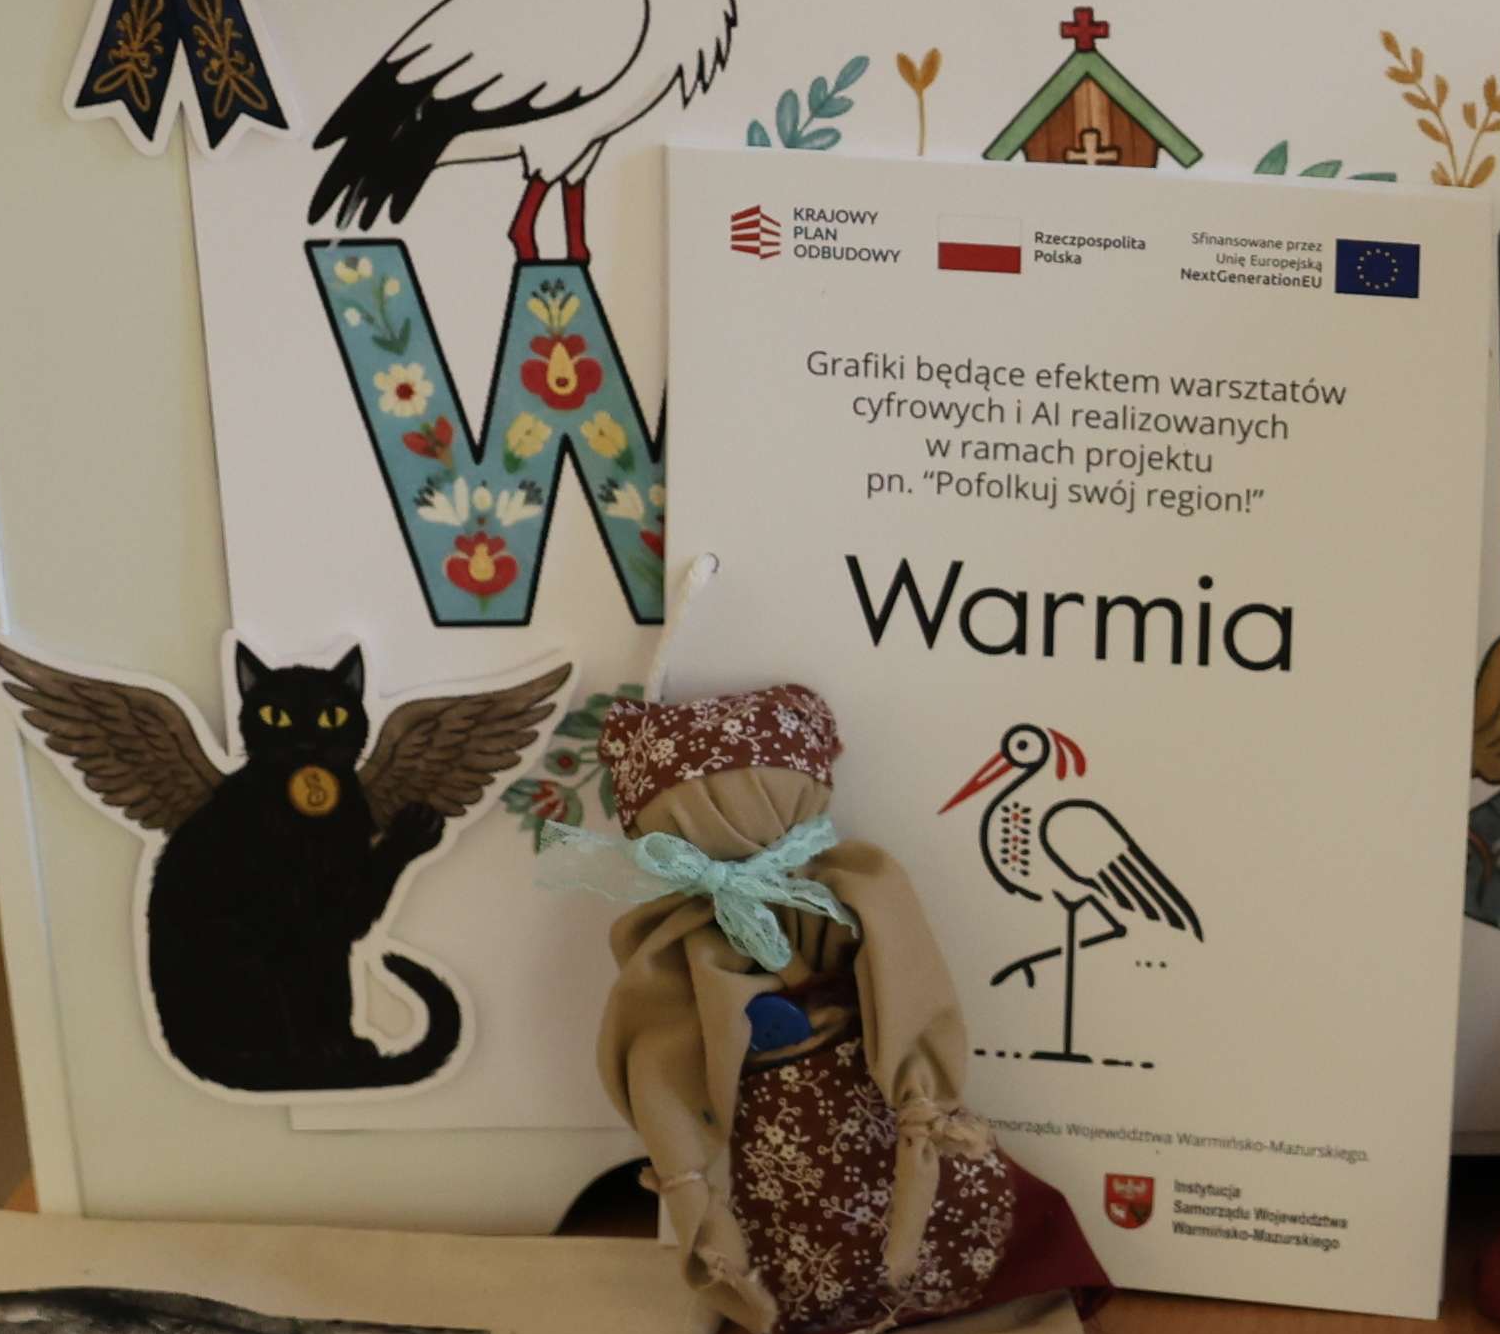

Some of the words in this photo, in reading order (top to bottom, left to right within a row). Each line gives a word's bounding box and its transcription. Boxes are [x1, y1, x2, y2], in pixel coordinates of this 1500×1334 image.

[792, 207, 878, 225] KRAJOWY
[793, 226, 838, 242] PLAN
[1034, 230, 1146, 251] Rzeczpospolita
[1191, 231, 1283, 250] Sfinansowane
[1286, 240, 1323, 255] przez
[793, 244, 901, 264] ODBUDOWY
[1034, 249, 1082, 266] Polska
[1215, 252, 1247, 267] Unię
[1250, 254, 1323, 273] Europejską
[1180, 267, 1323, 289] NextGenerationEU
[806, 350, 905, 380] Grafiki
[916, 355, 1025, 392] będące
[1035, 363, 1160, 395] efektem
[1170, 373, 1347, 406] warsztatów
[852, 391, 1005, 428] cyfrowych
[1015, 399, 1022, 424] i
[1031, 401, 1060, 427] AI
[1071, 404, 1289, 445] realizowanych
[925, 438, 951, 458] w
[961, 438, 1074, 465] ramach
[1085, 444, 1214, 477] projektu
[866, 471, 913, 499] pn.
[1067, 478, 1136, 514] swój
[844, 553, 1295, 673] Warmia
[1066, 1122, 1173, 1144] Województwa
[1173, 1179, 1242, 1200] Instytucja
[1172, 1199, 1250, 1222] Samorządu
[1253, 1207, 1349, 1230] Województwa
[1171, 1220, 1341, 1252] Warmińsko-Mazurskiego
